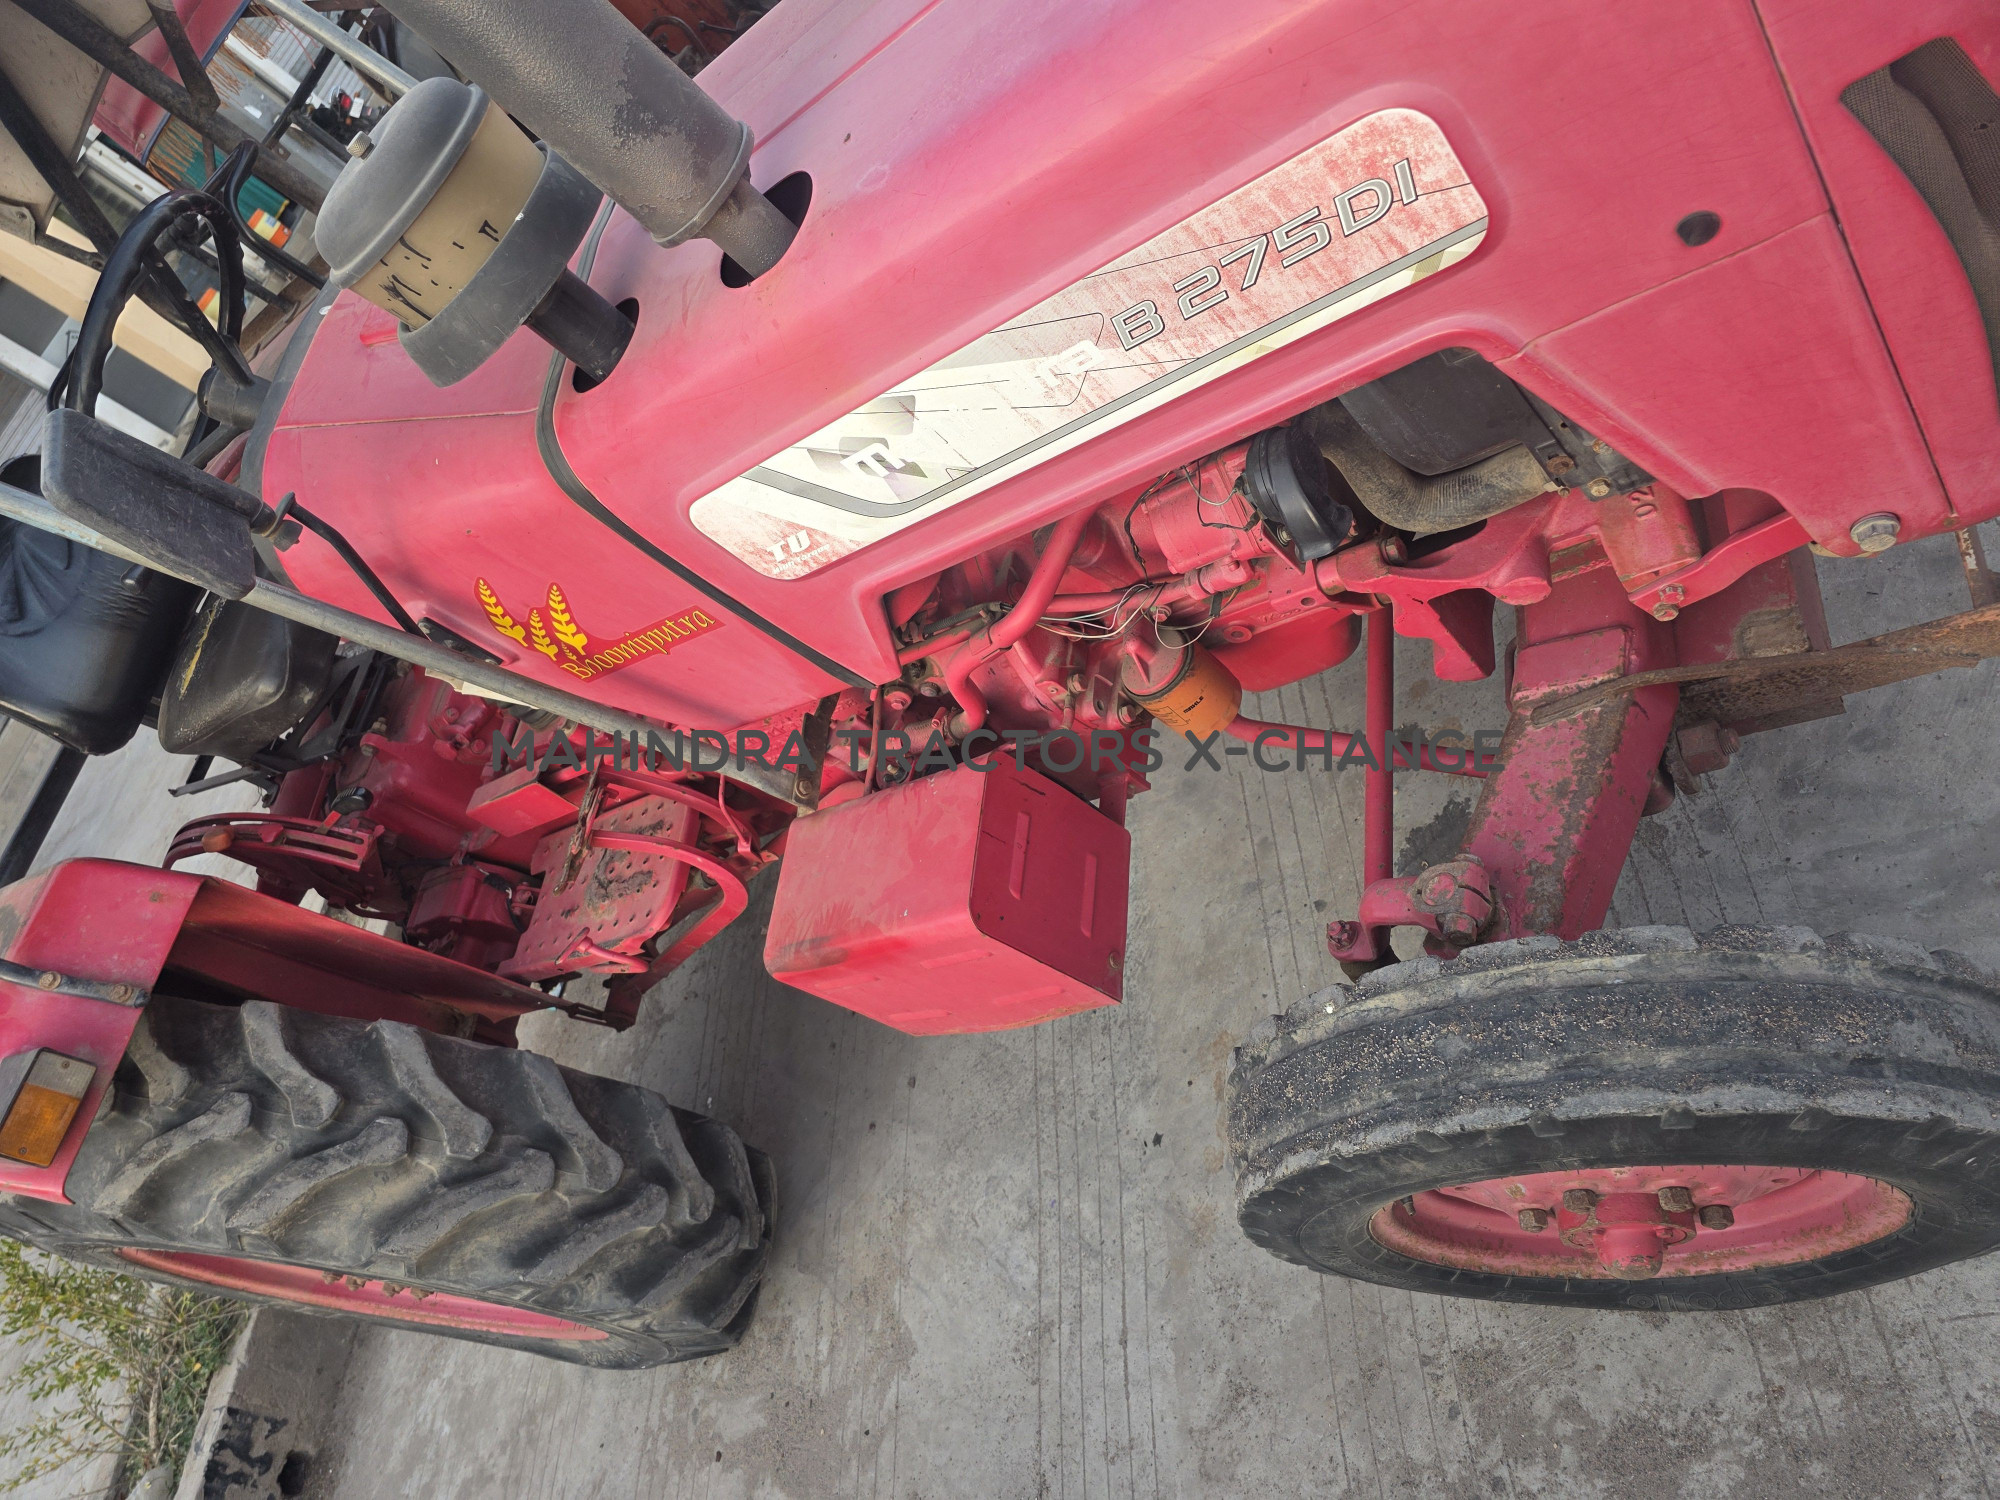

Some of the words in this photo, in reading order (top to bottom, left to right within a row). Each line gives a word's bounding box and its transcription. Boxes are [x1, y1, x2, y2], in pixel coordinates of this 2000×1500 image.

[1110, 299, 1165, 351] B
[560, 609, 716, 680] Bhoomiputra
[1183, 695, 1205, 714] MAHLE
[1627, 1279, 1784, 1312] apollo
